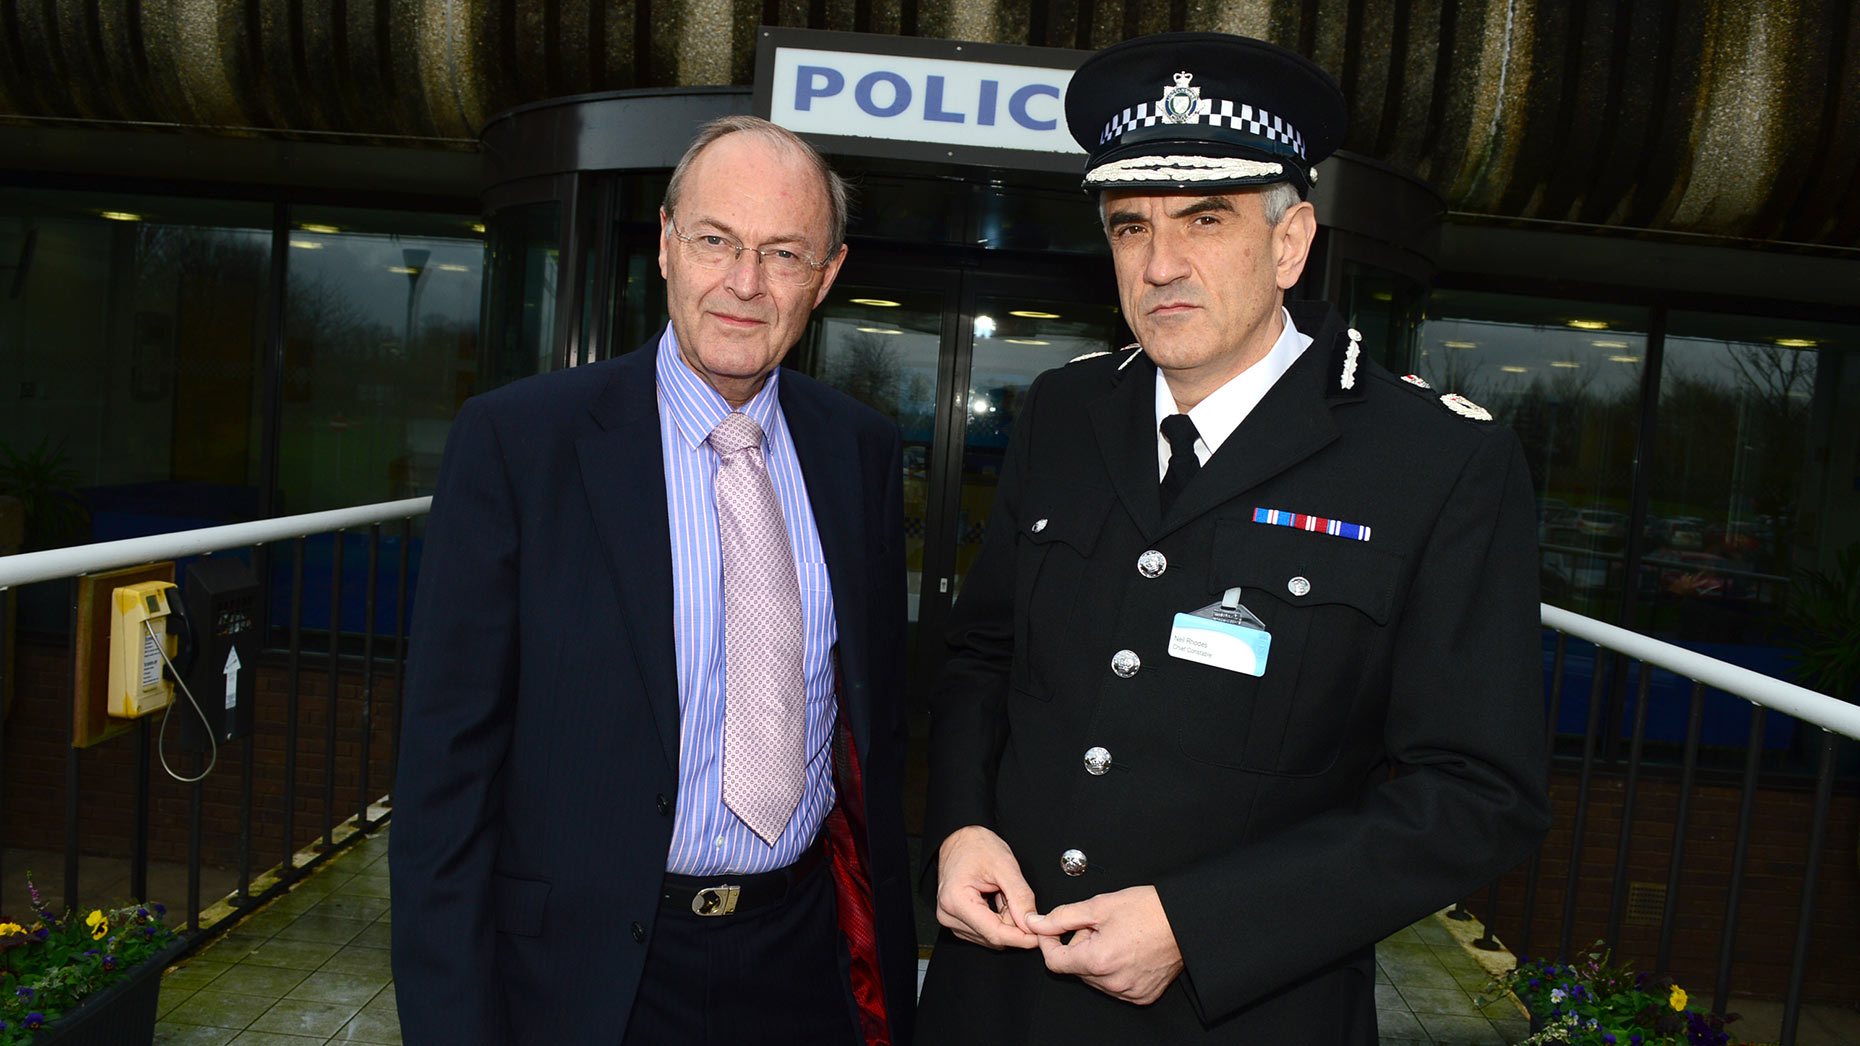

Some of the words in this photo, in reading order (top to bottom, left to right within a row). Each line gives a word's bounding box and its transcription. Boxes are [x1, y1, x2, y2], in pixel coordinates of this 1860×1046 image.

[794, 64, 1060, 132] POLIC
[1174, 635, 1185, 643] Neil
[1186, 636, 1208, 648] Rhodes
[1172, 644, 1186, 652] Chief
[1186, 647, 1212, 658] Constable
